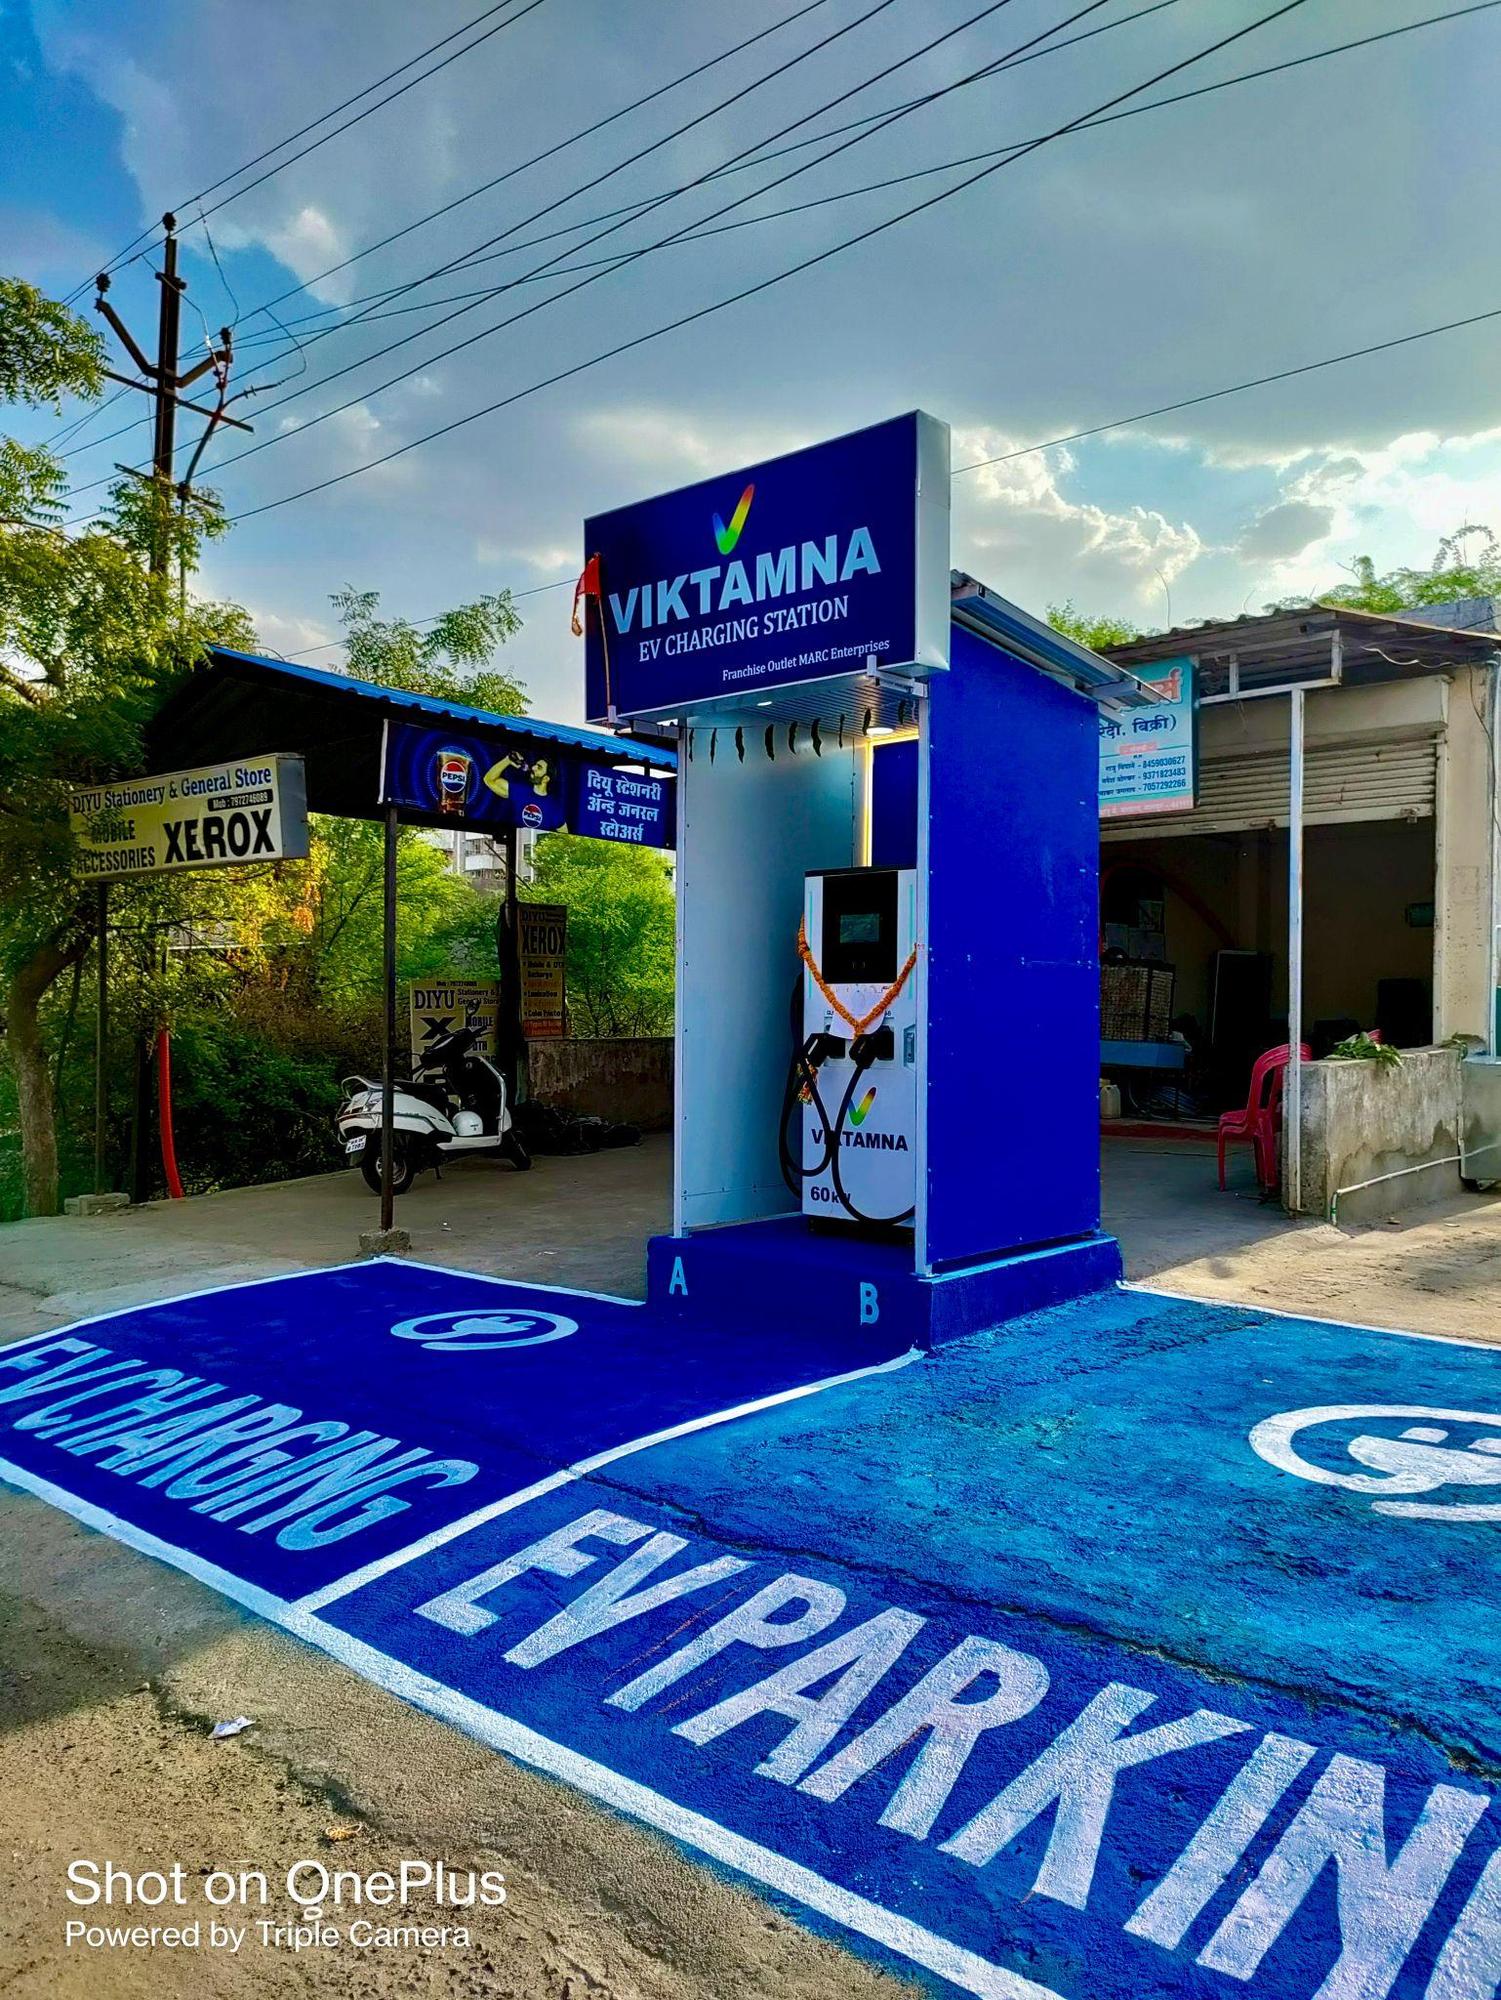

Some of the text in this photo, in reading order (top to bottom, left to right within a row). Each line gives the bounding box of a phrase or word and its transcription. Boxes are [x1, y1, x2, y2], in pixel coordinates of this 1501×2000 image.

[609, 526, 881, 634] VIKTAMNA
[639, 595, 849, 662] EV CHARGING STATION
[722, 640, 890, 681] Franchise Outlet MARC Enterprises
[73, 767, 272, 814] DIYU Stationery & General Store
[442, 772, 467, 781] PEPSI
[618, 802, 660, 822] जनरल
[163, 808, 276, 864] XEROX
[414, 990, 455, 1010] DIYU
[668, 1256, 688, 1295] A
[860, 1281, 879, 1325] B
[13, 1369, 479, 1550] CHARGING
[412, 1509, 1501, 2000] EV PARKIN
